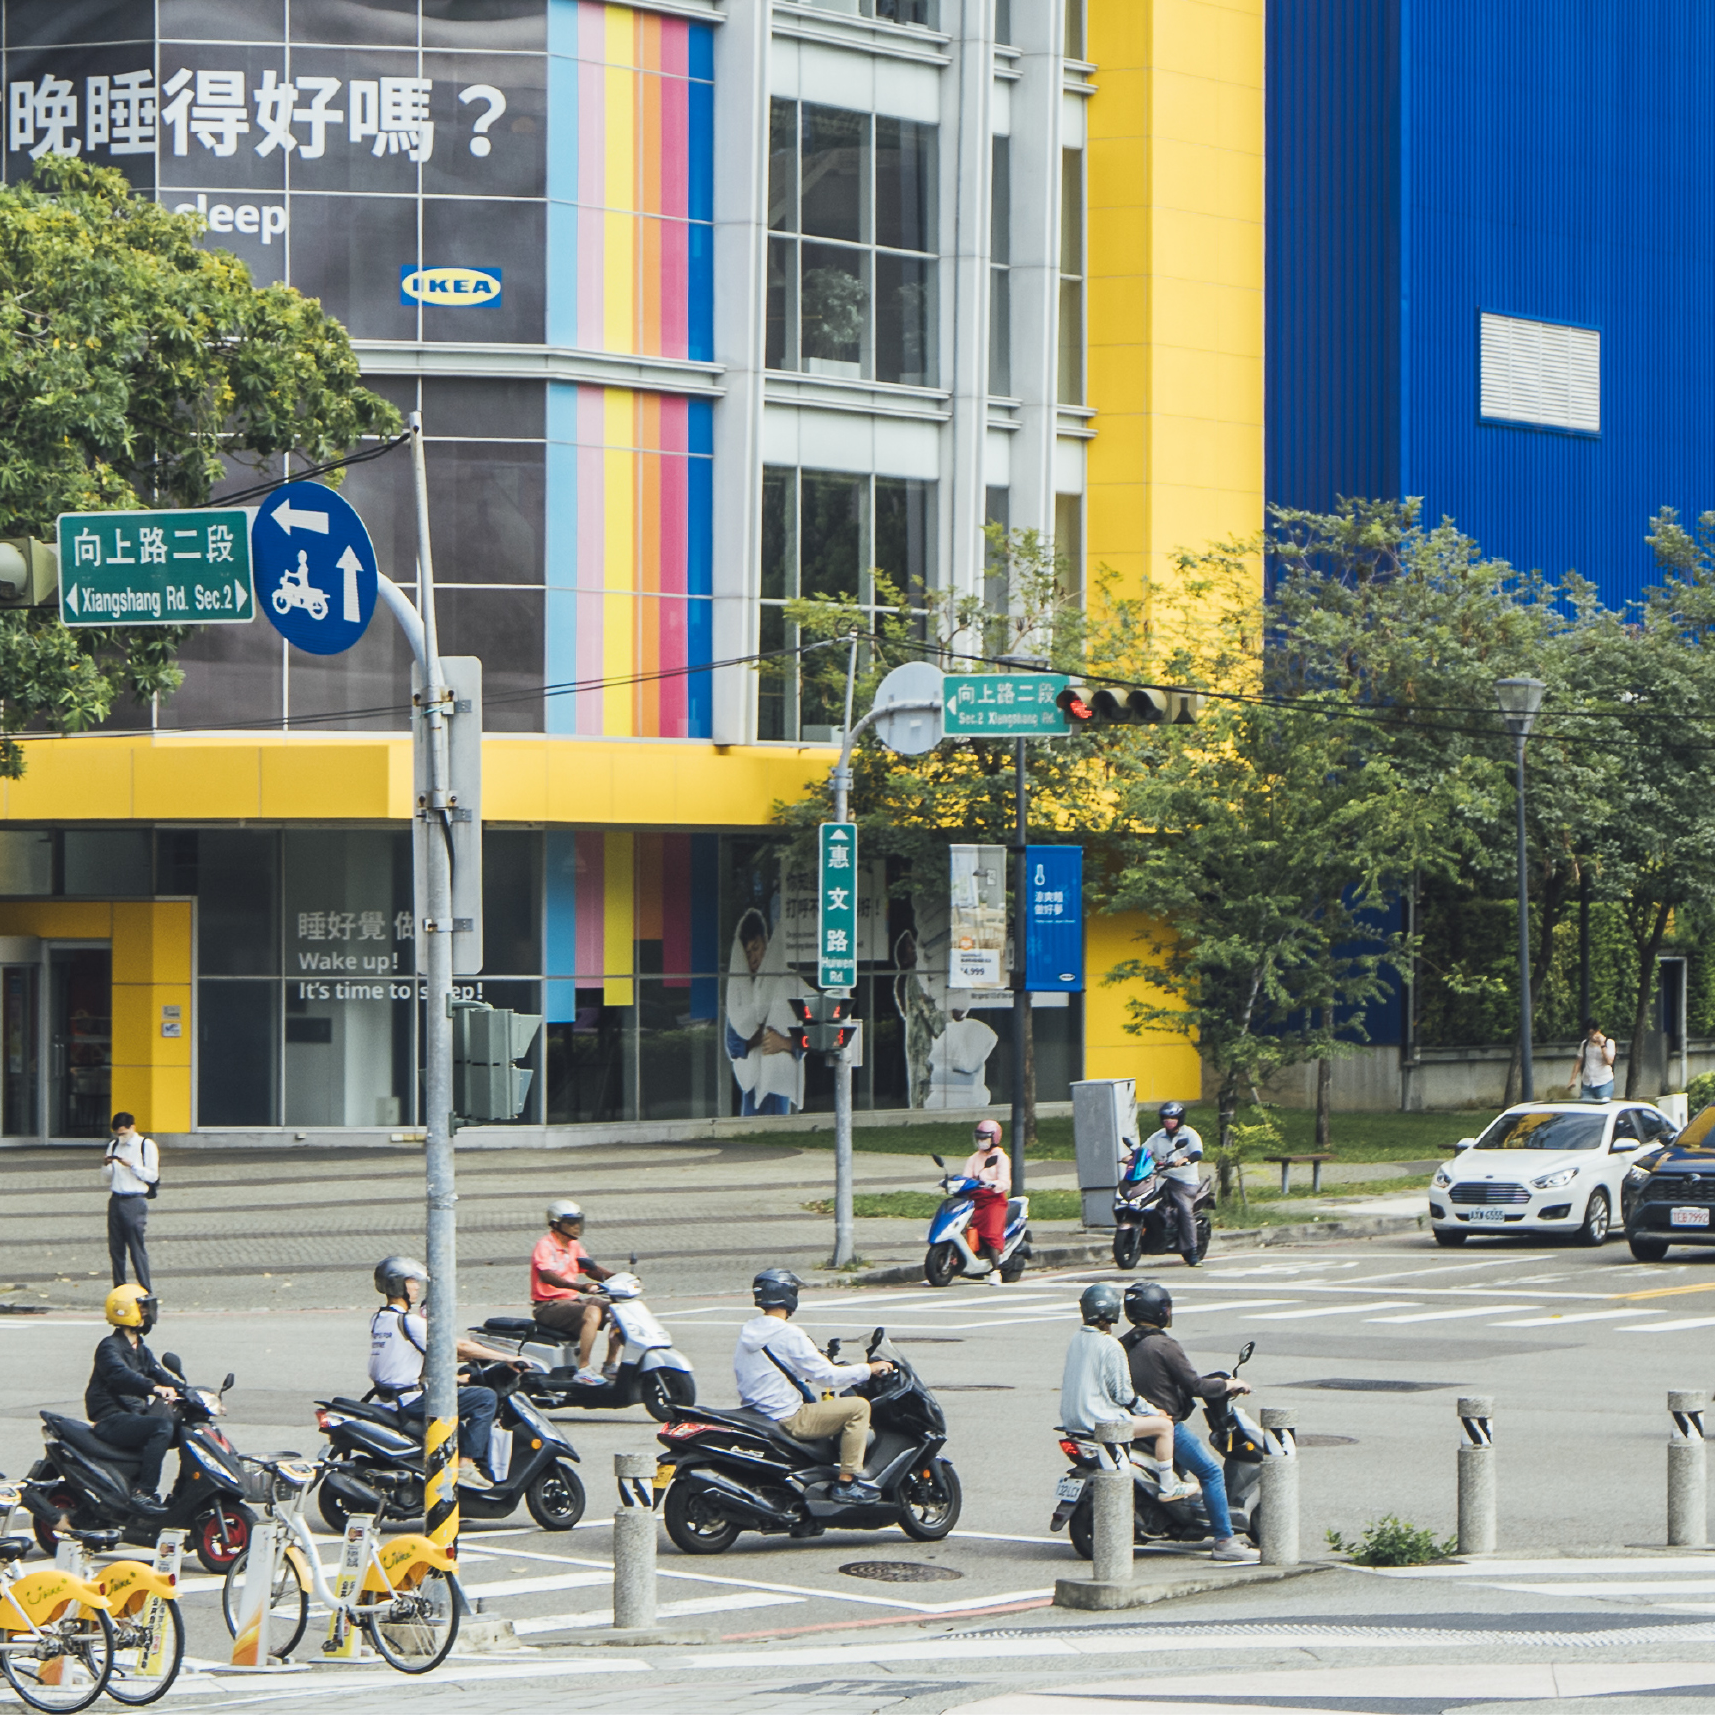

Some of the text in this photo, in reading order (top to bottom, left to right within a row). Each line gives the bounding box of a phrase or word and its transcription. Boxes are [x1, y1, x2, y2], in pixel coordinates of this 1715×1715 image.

[412, 279, 493, 294] IKEA
[74, 524, 234, 567] 向上路二段
[82, 583, 233, 619] Xiangshang Rd. Sec.2
[958, 683, 1055, 704] 向上路二段
[827, 845, 849, 952] 惠文路
[298, 911, 386, 941] 睡好覺
[299, 952, 398, 974] Wake up!
[300, 982, 483, 1000] It's time to sep!
